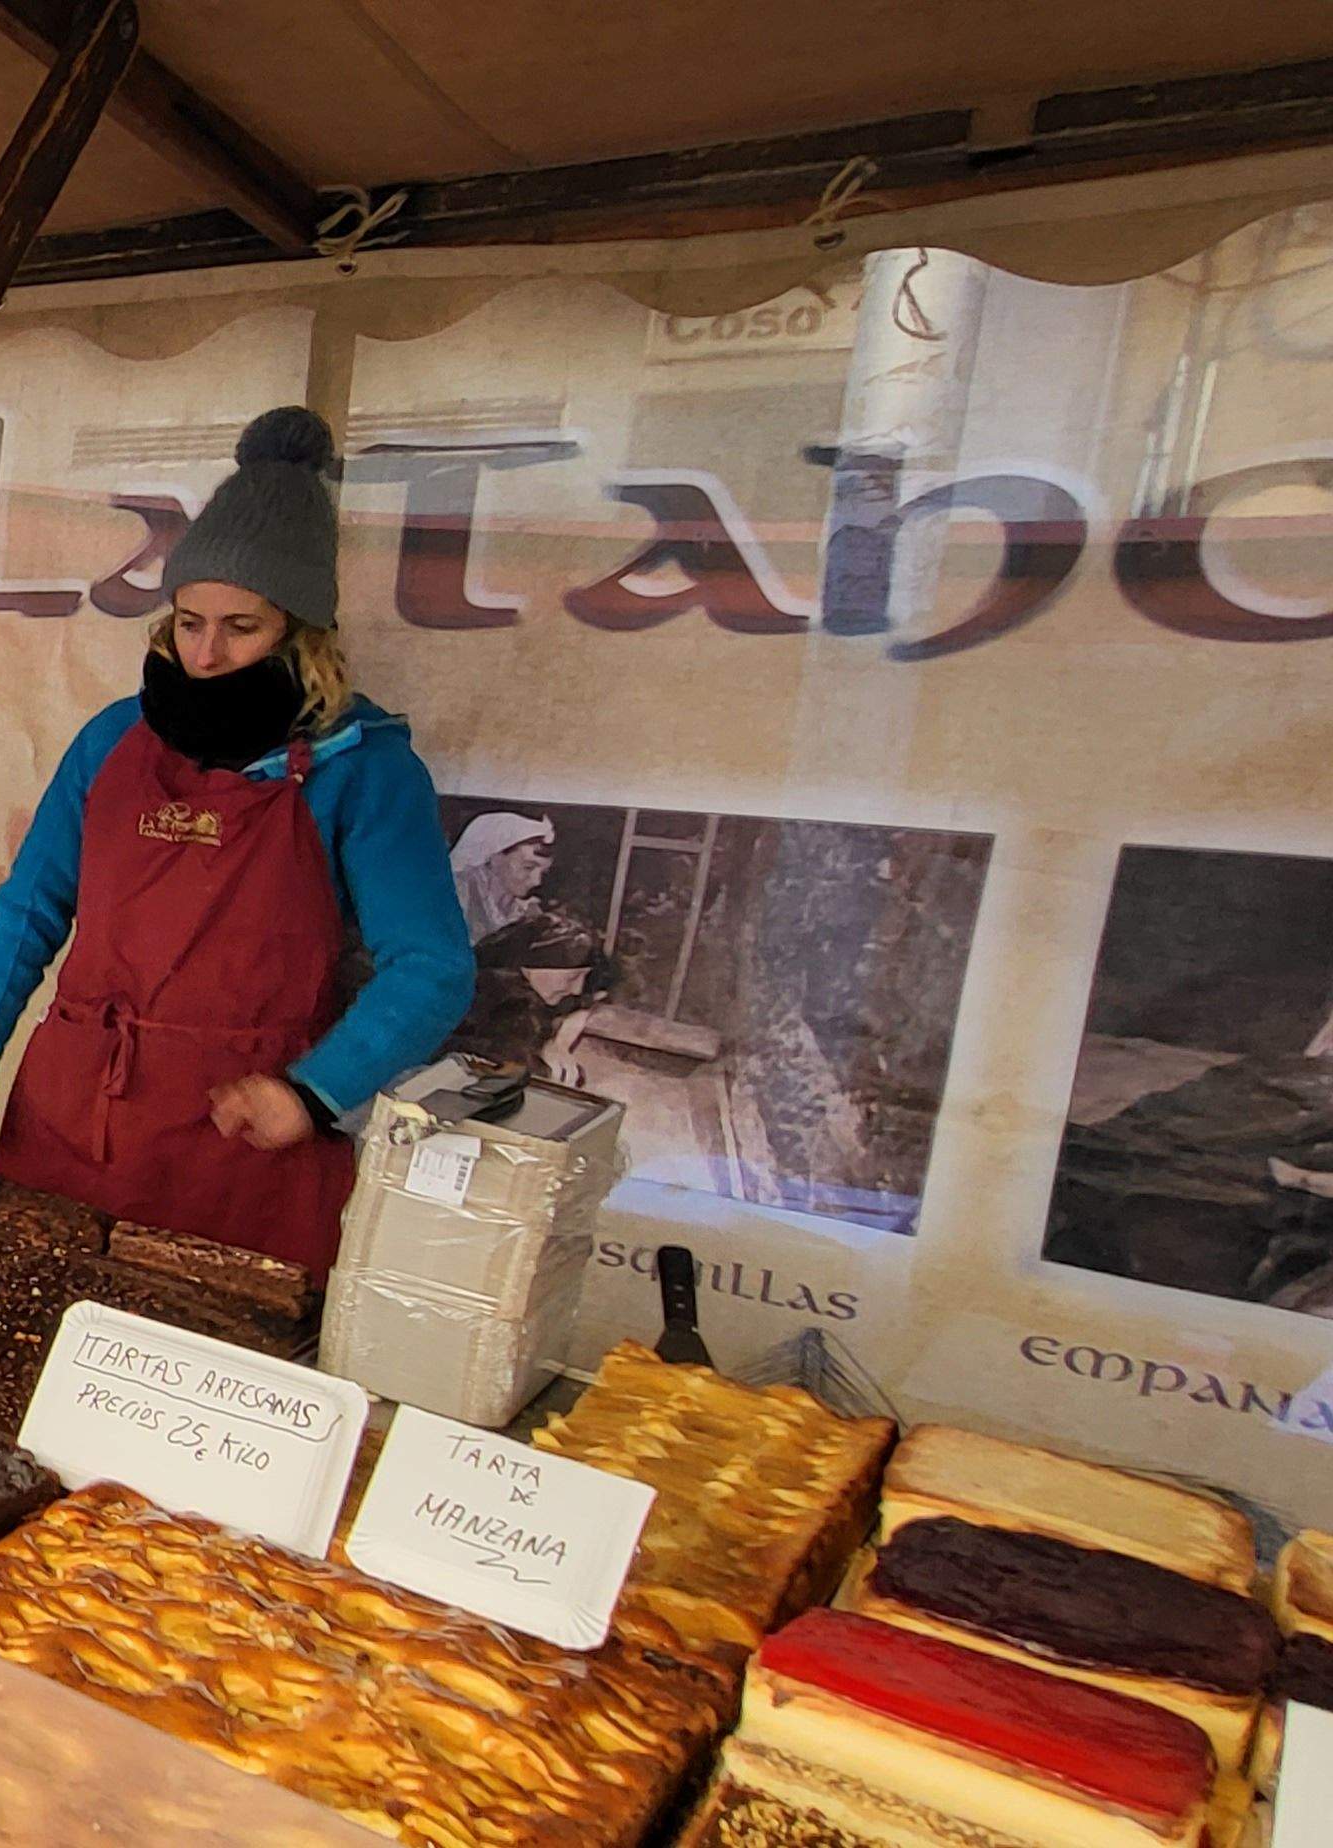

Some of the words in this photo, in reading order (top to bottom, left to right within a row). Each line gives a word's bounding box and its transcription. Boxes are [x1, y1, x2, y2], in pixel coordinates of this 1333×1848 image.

[86, 1334, 191, 1386] TARTAS
[195, 1370, 321, 1428] ARTESANAS
[446, 1435, 542, 1488] TARTA
[509, 1485, 537, 1506] DE
[414, 1493, 567, 1566] MANZANA
